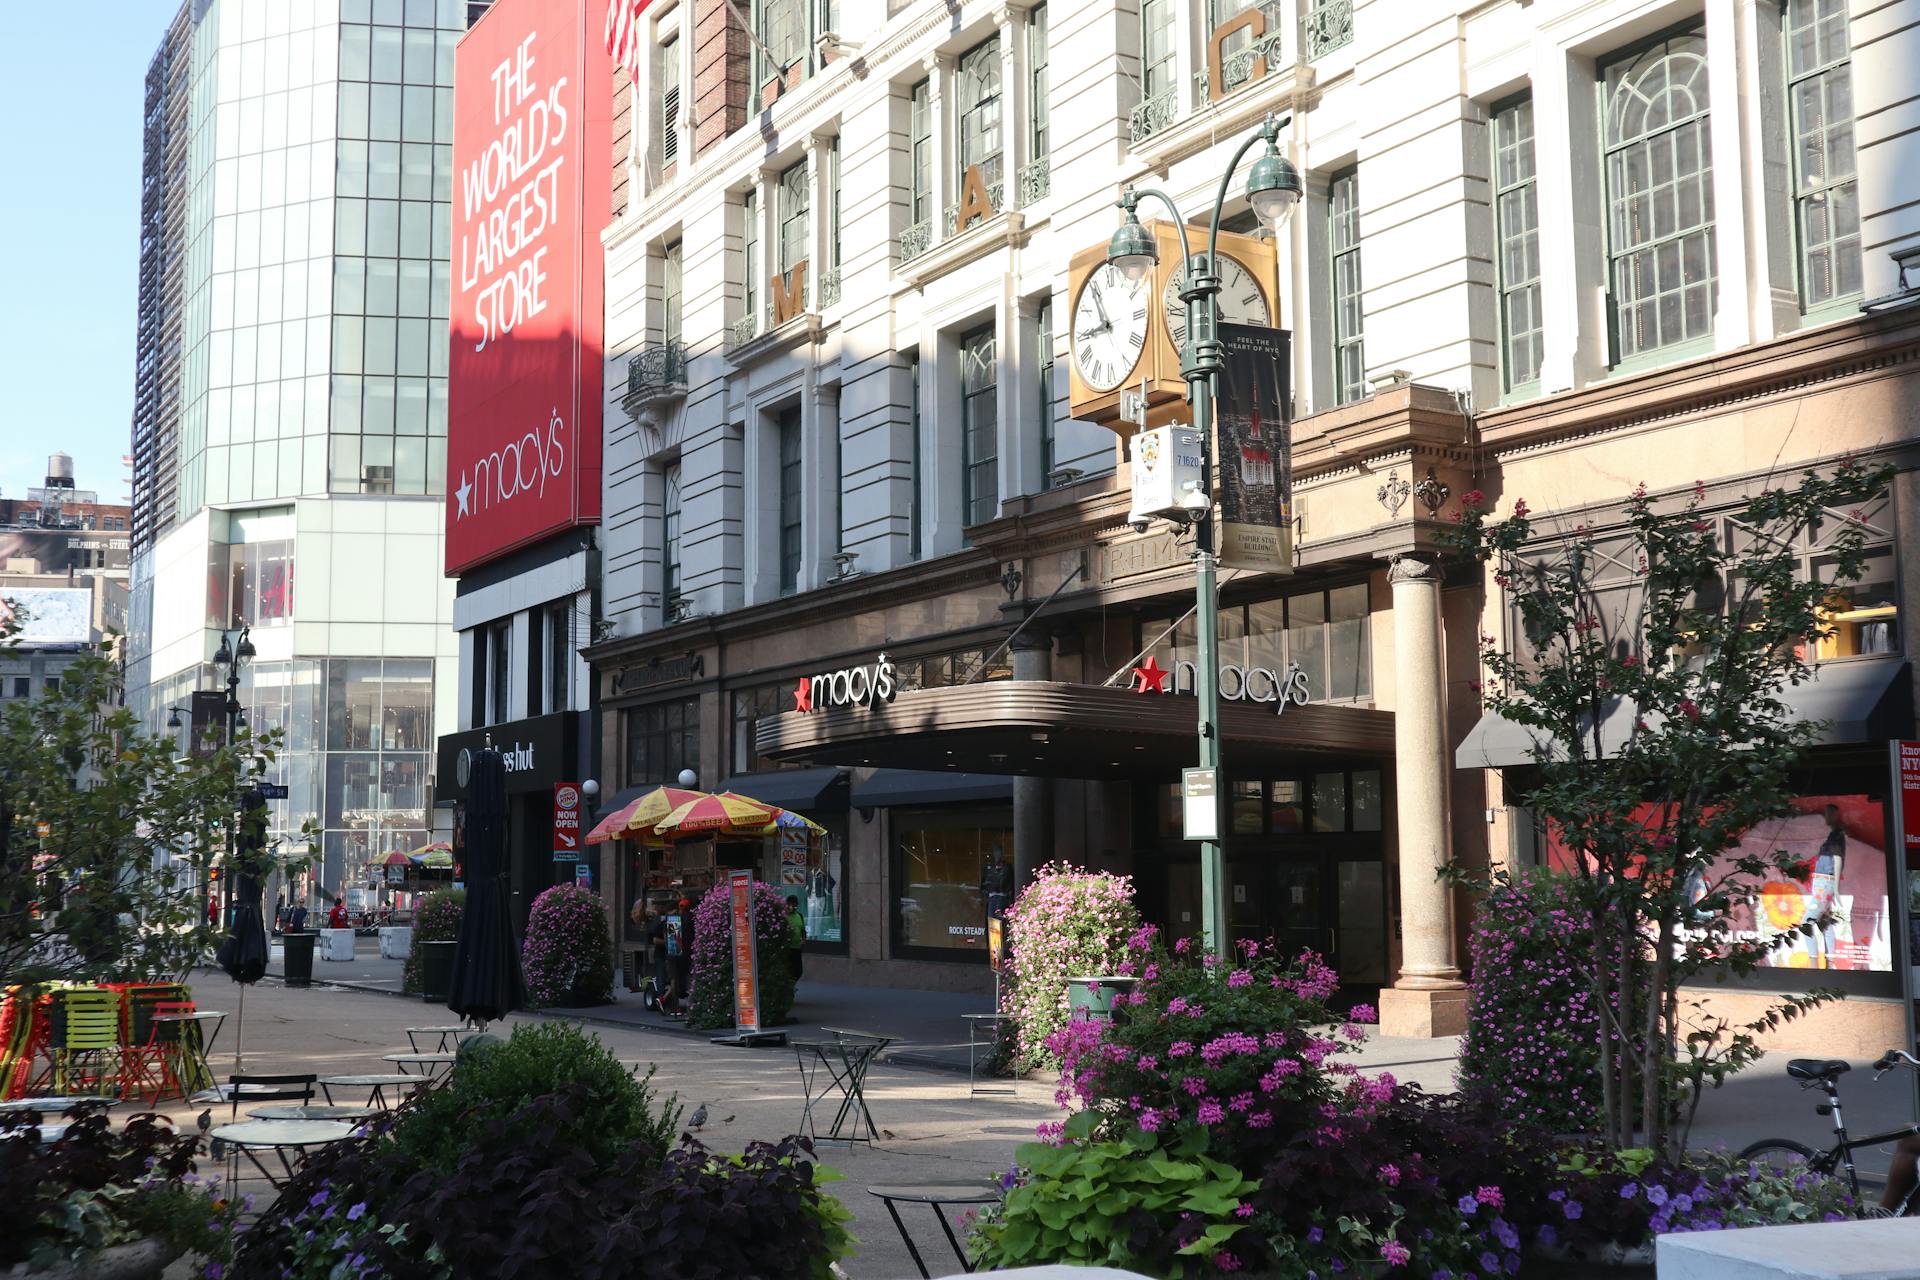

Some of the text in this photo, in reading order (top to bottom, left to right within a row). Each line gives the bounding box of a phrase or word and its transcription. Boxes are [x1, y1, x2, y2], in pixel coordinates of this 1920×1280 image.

[490, 30, 537, 126] THE
[462, 76, 567, 222] WORLD'S
[461, 155, 565, 293] LARGEST
[475, 246, 548, 353] STORE
[1227, 342, 1251, 351] HEART
[1236, 336, 1270, 346] FEEL THE
[473, 406, 564, 515] macy's
[67, 541, 100, 549] DOLPHINS
[1238, 534, 1278, 545] EMPIRE STATE
[1243, 542, 1274, 551] BUILDING
[811, 652, 894, 712] macy's
[1902, 744, 1920, 756] kno
[515, 742, 535, 772] hut
[1903, 758, 1920, 771] NY
[560, 795, 577, 804] KING
[557, 811, 577, 820] NOW
[555, 819, 579, 829] OPEN
[948, 926, 986, 936] ROCK STEADY
